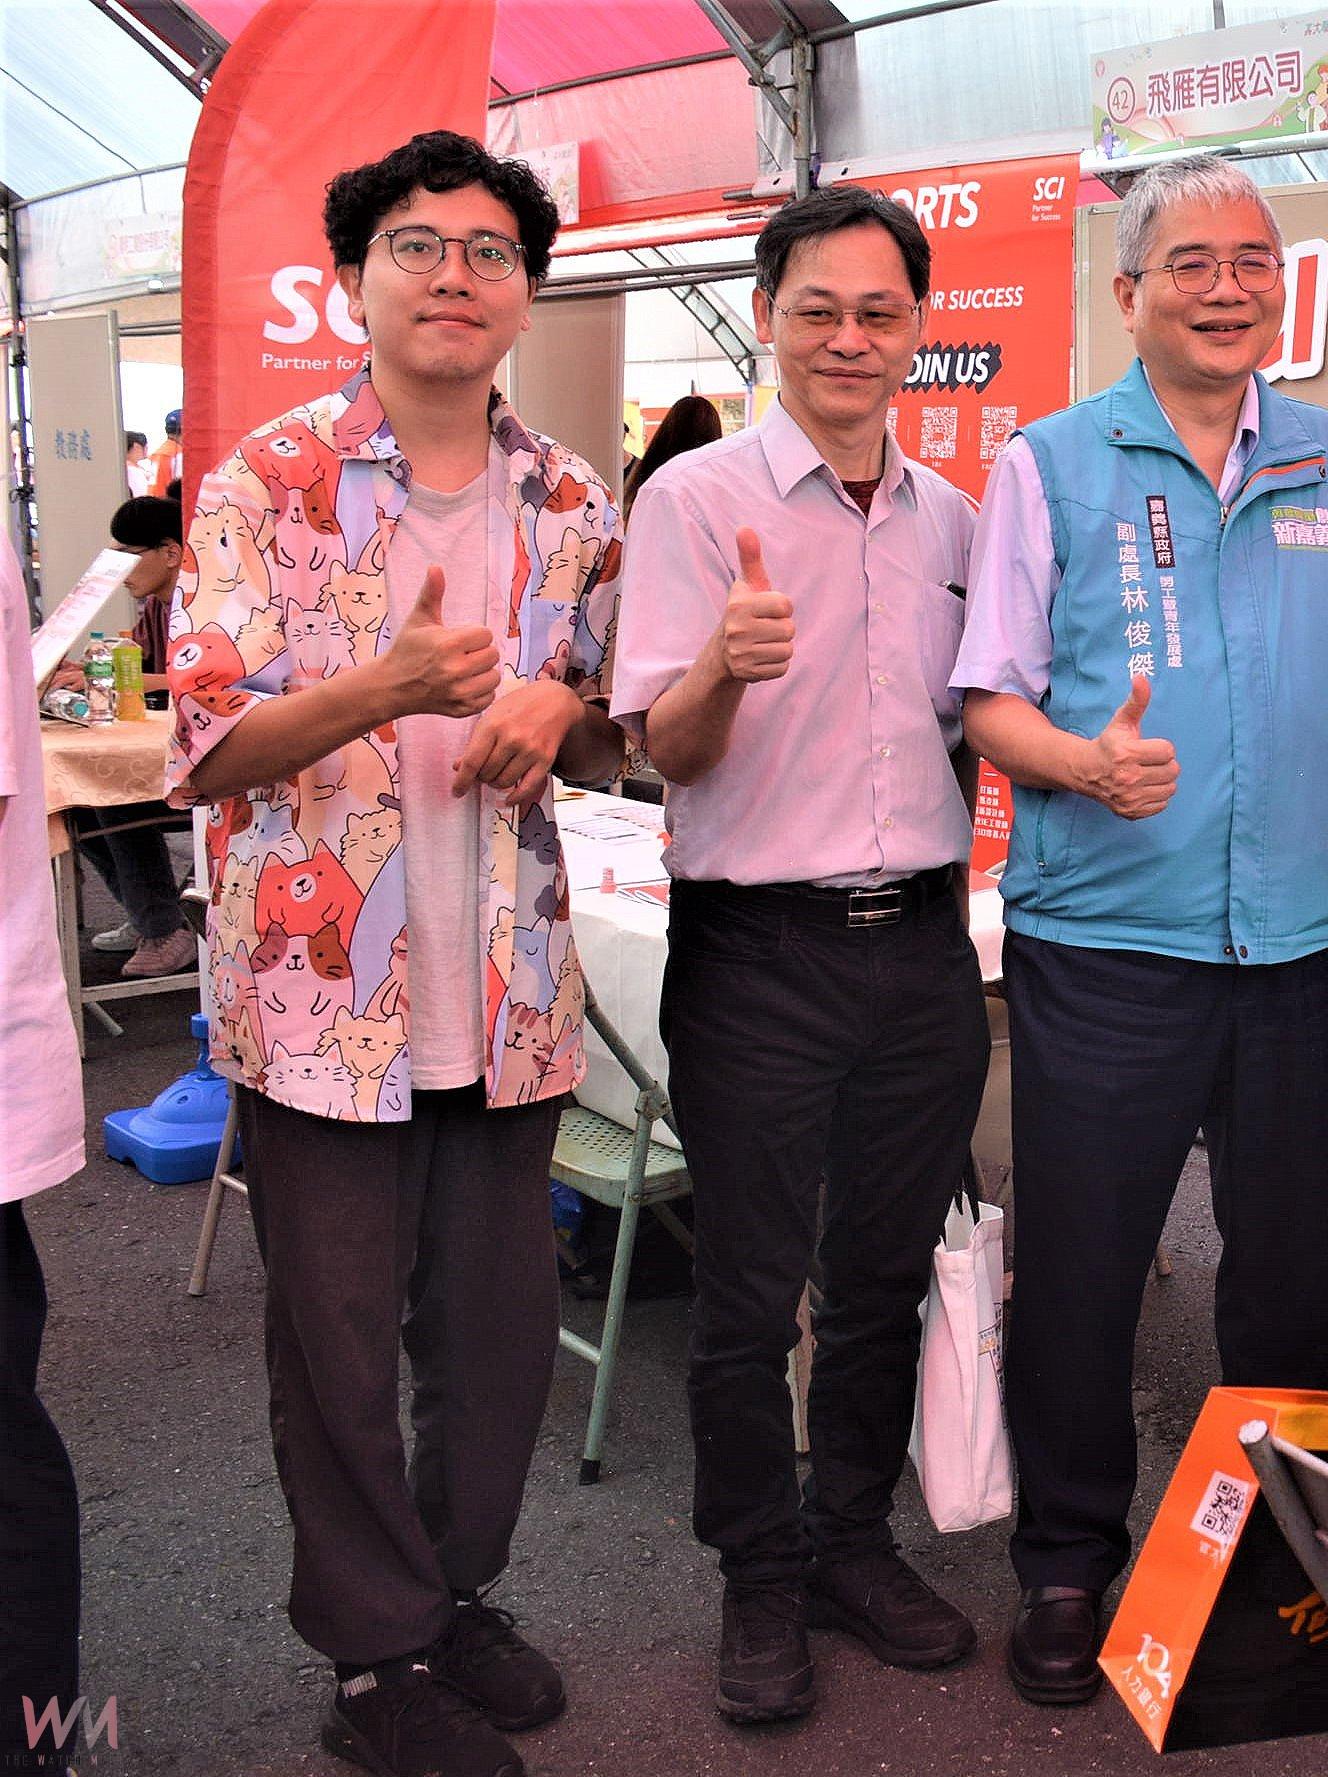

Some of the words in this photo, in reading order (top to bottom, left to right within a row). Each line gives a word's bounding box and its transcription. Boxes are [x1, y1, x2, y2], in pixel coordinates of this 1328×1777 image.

[1148, 50, 1300, 115] 飛雁有限公司
[1112, 90, 1128, 110] 42
[1033, 177, 1065, 201] SCI
[948, 286, 1024, 310] SUCCESS
[262, 353, 331, 370] Partner
[336, 355, 359, 369] for
[955, 351, 990, 383] US
